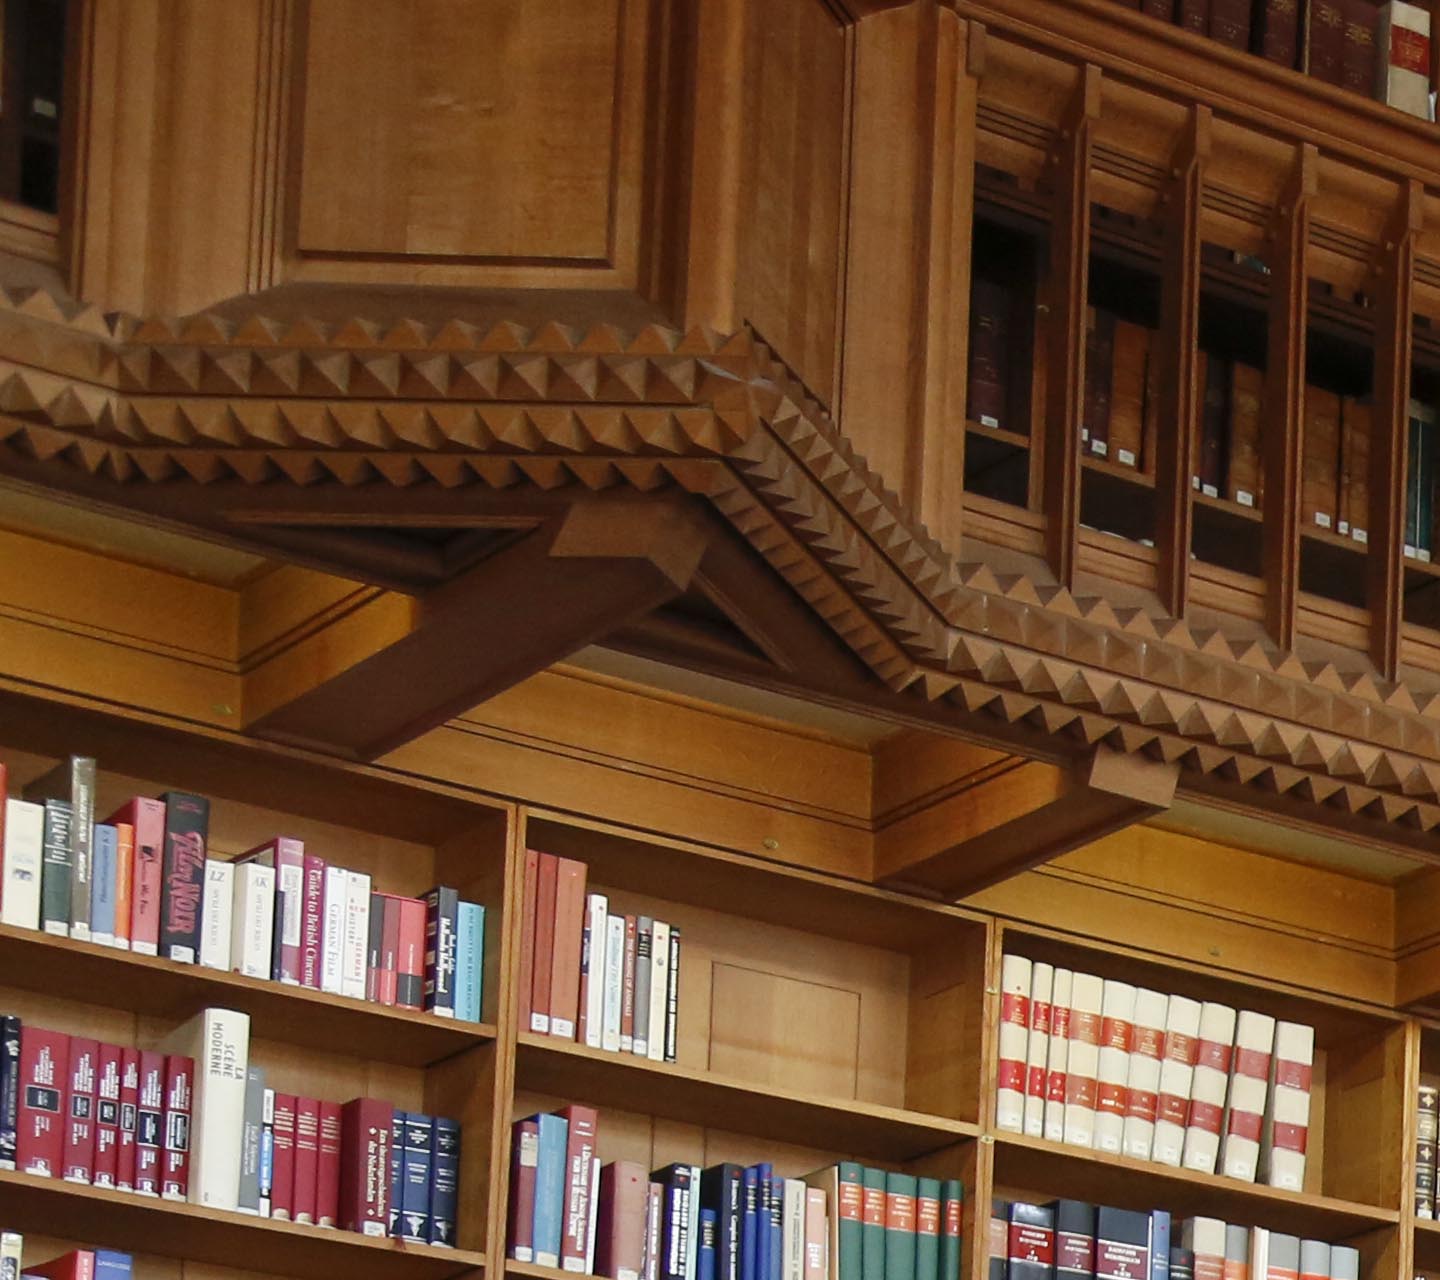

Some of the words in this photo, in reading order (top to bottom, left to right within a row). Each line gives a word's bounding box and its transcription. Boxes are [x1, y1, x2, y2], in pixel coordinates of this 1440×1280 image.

[309, 869, 323, 900] Guide
[306, 914, 320, 946] British
[211, 1022, 223, 1076] MODERNE
[223, 1043, 235, 1078] SCÈNE
[235, 1067, 244, 1080] LA
